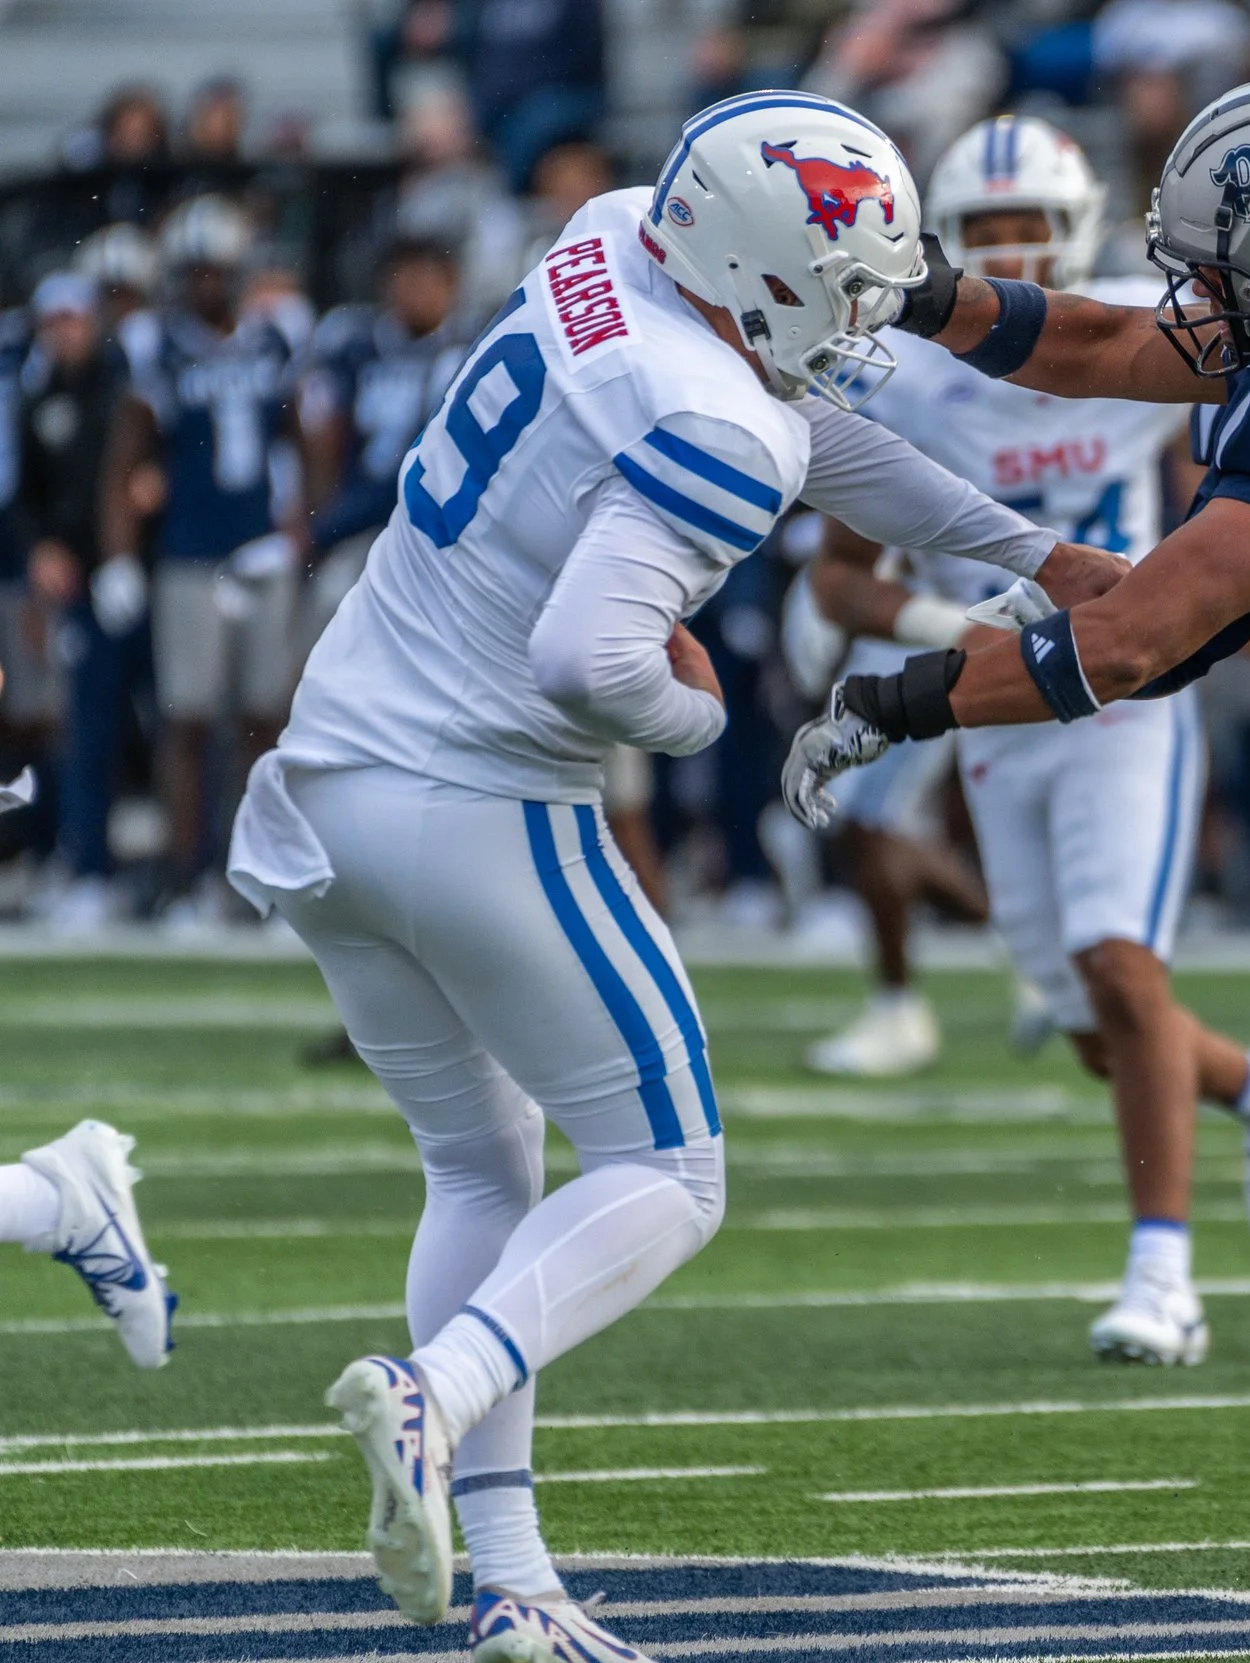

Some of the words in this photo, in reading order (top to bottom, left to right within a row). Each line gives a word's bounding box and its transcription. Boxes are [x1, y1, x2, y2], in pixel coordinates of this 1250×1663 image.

[669, 203, 692, 222] ACC
[545, 238, 628, 357] PEARSON
[404, 286, 546, 550] 9
[990, 433, 1107, 487] SMU
